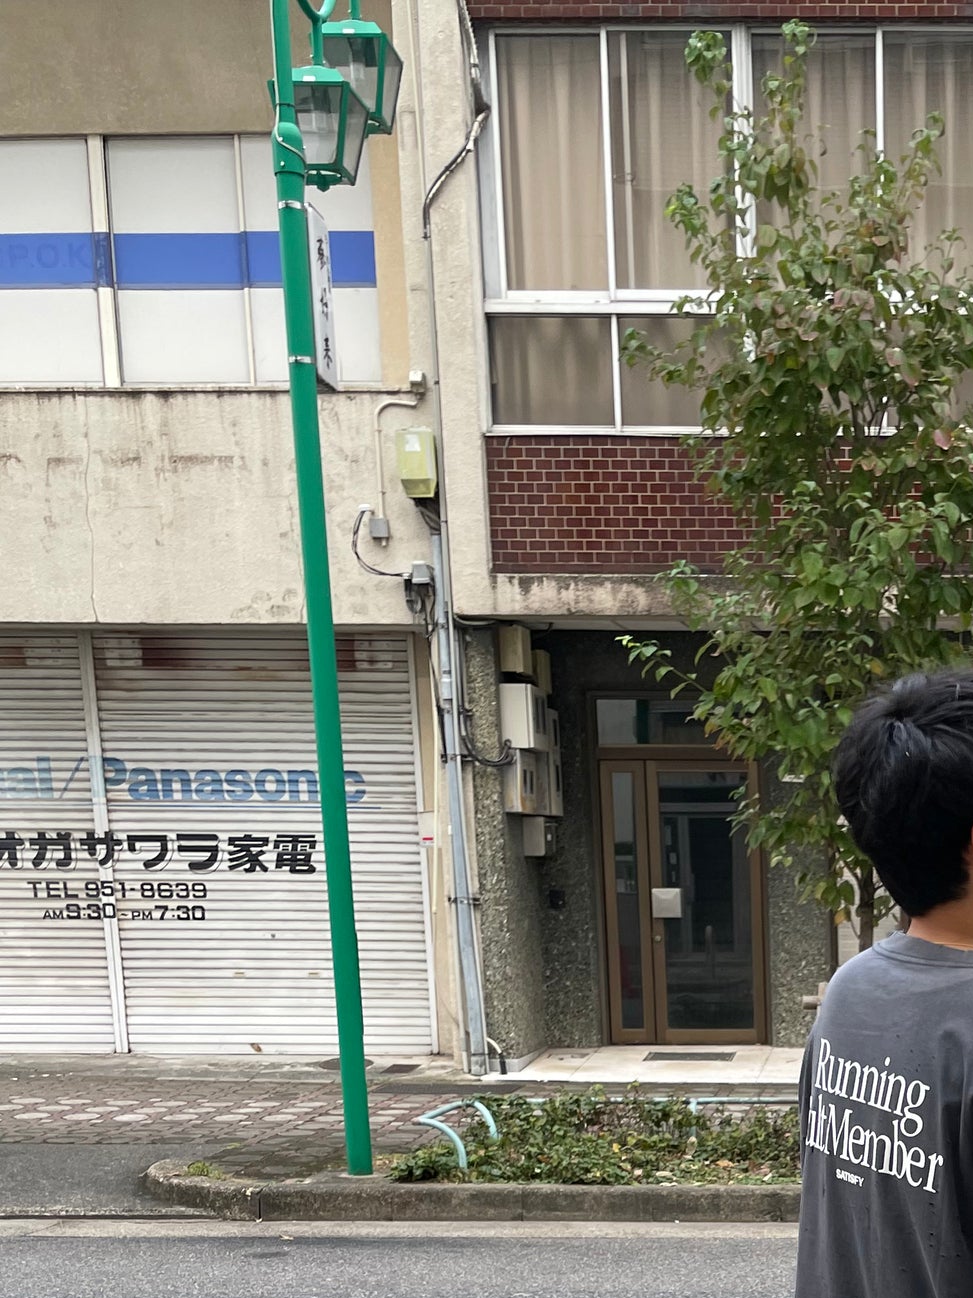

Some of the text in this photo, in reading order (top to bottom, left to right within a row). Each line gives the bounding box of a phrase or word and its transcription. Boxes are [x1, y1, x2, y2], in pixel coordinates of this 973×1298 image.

[88, 756, 366, 805] Panasonc
[0, 831, 317, 875] オガサワラ家電
[27, 880, 208, 899] TEL 951-8639
[814, 1037, 931, 1137] Running
[835, 1168, 865, 1187] SATISFY
